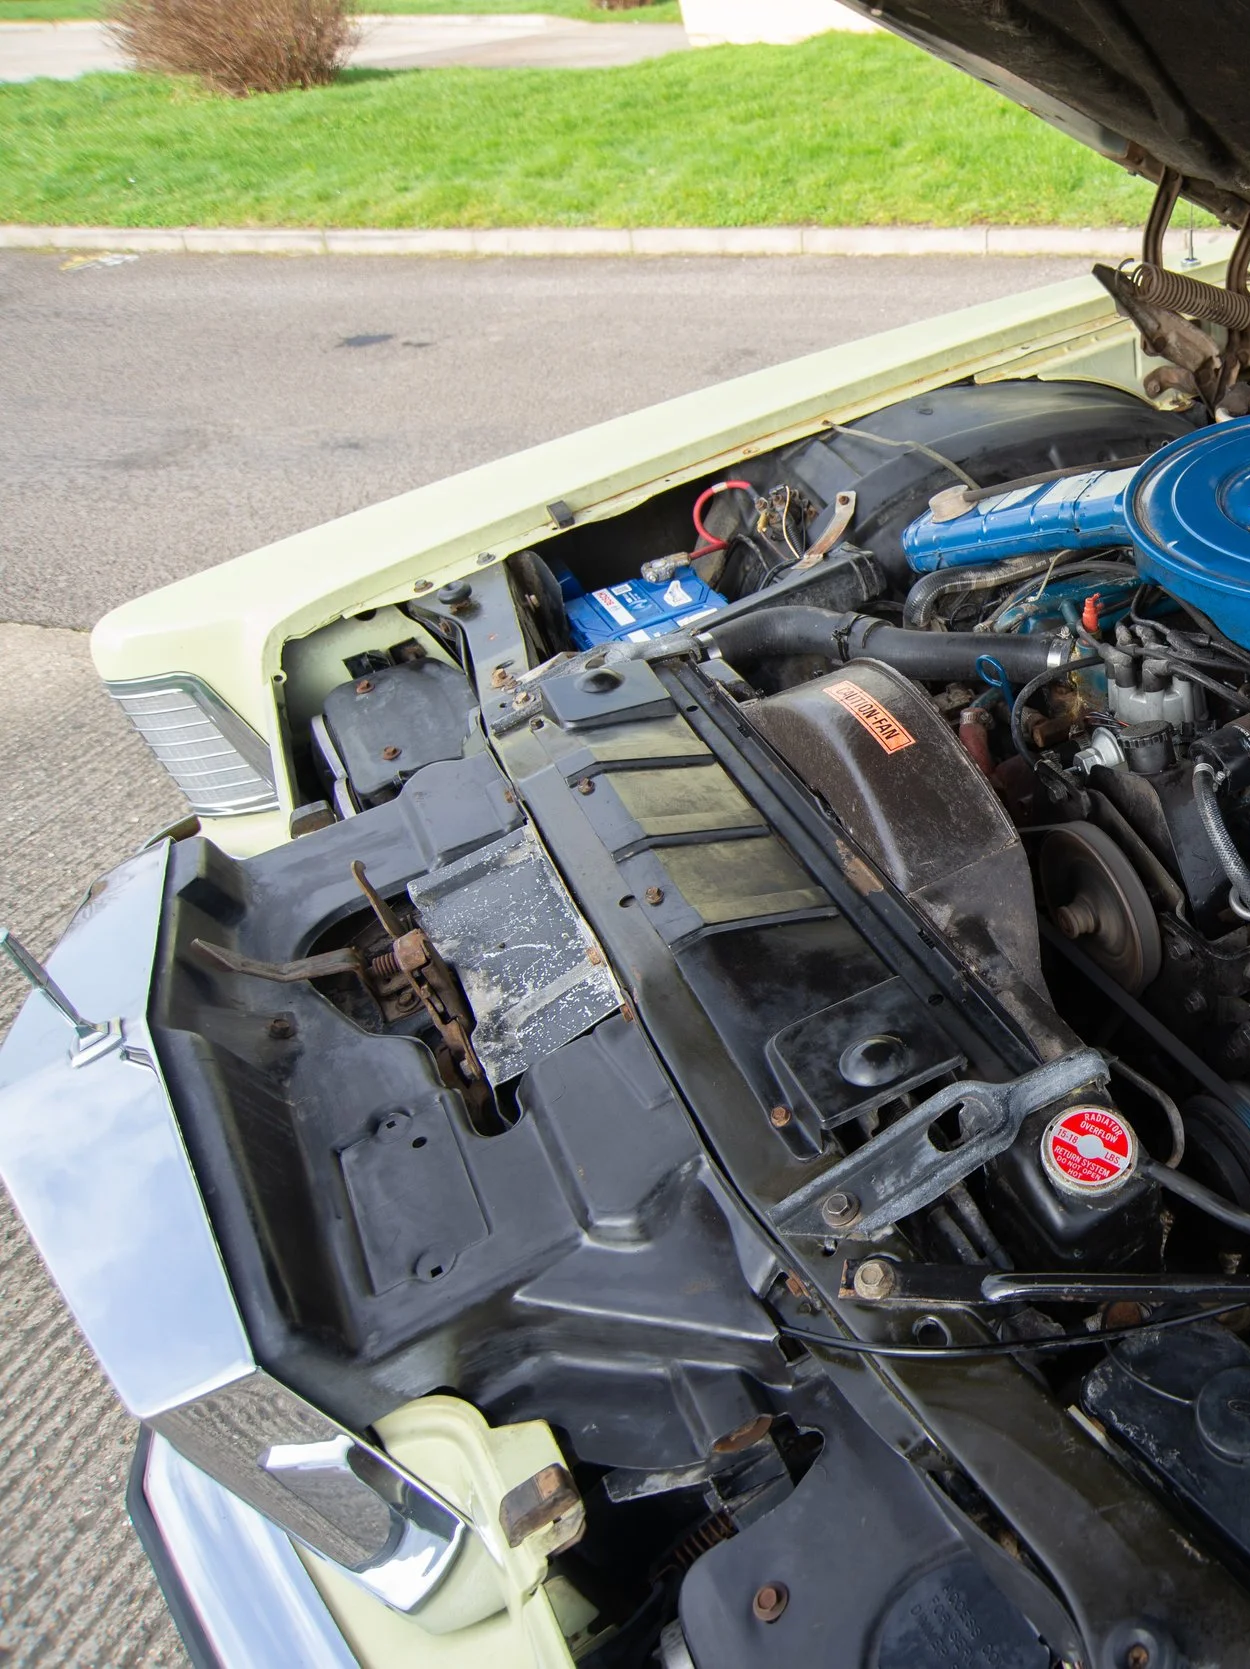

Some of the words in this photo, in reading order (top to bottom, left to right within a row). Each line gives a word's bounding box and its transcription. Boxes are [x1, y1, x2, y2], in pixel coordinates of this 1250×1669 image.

[836, 687, 900, 740] CAUTION-FAN
[1080, 1121, 1118, 1144] OVERFLOW
[1084, 1113, 1123, 1136] RADIATOR
[1057, 1128, 1078, 1144] 15-18
[1104, 1151, 1121, 1166] LBS.
[1054, 1145, 1082, 1164] RETURN
[1081, 1158, 1110, 1178] SYSTEM
[1056, 1155, 1067, 1164] DO
[1068, 1160, 1081, 1170] NOT
[1082, 1168, 1102, 1181] OPEN
[1067, 1168, 1082, 1179] HOT
[931, 1594, 952, 1625] FOR
